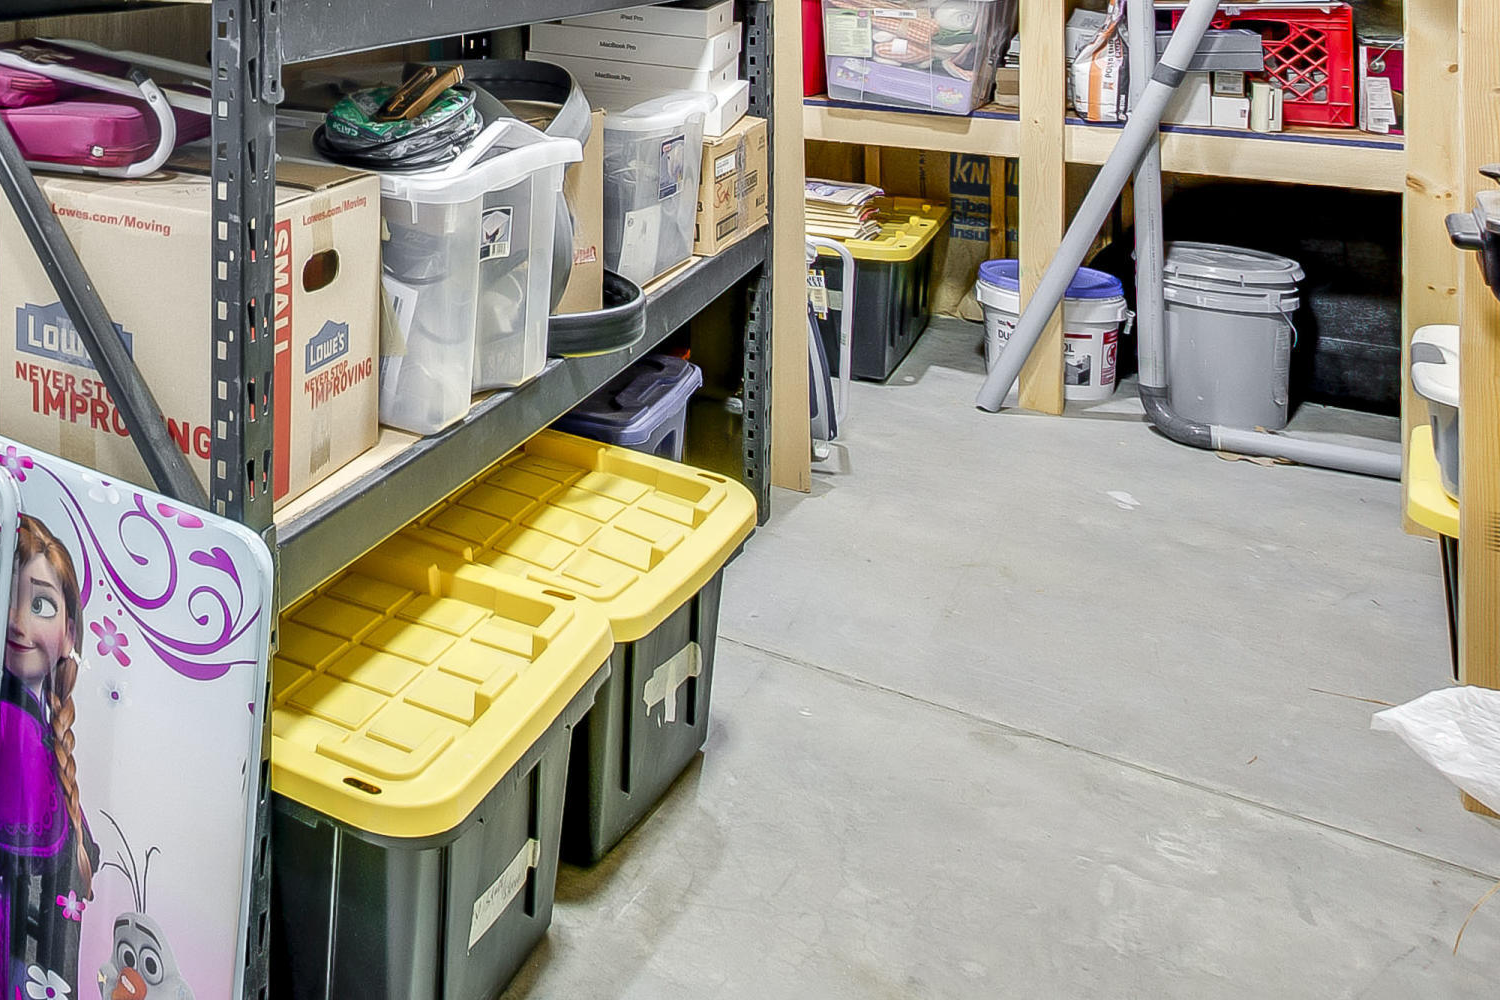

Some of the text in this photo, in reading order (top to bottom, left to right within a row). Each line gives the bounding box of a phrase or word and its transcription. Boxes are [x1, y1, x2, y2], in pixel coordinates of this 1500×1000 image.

[634, 14, 644, 22] Pro
[600, 41, 626, 50] MacBook
[594, 71, 632, 82] MacBook Pro
[52, 203, 171, 236] Lowes.com/Moving
[302, 196, 367, 226] Lowes.com/Moving
[15, 361, 76, 392] NEVER
[304, 359, 349, 394] NEVER STOP
[311, 357, 372, 410] IMPROVING
